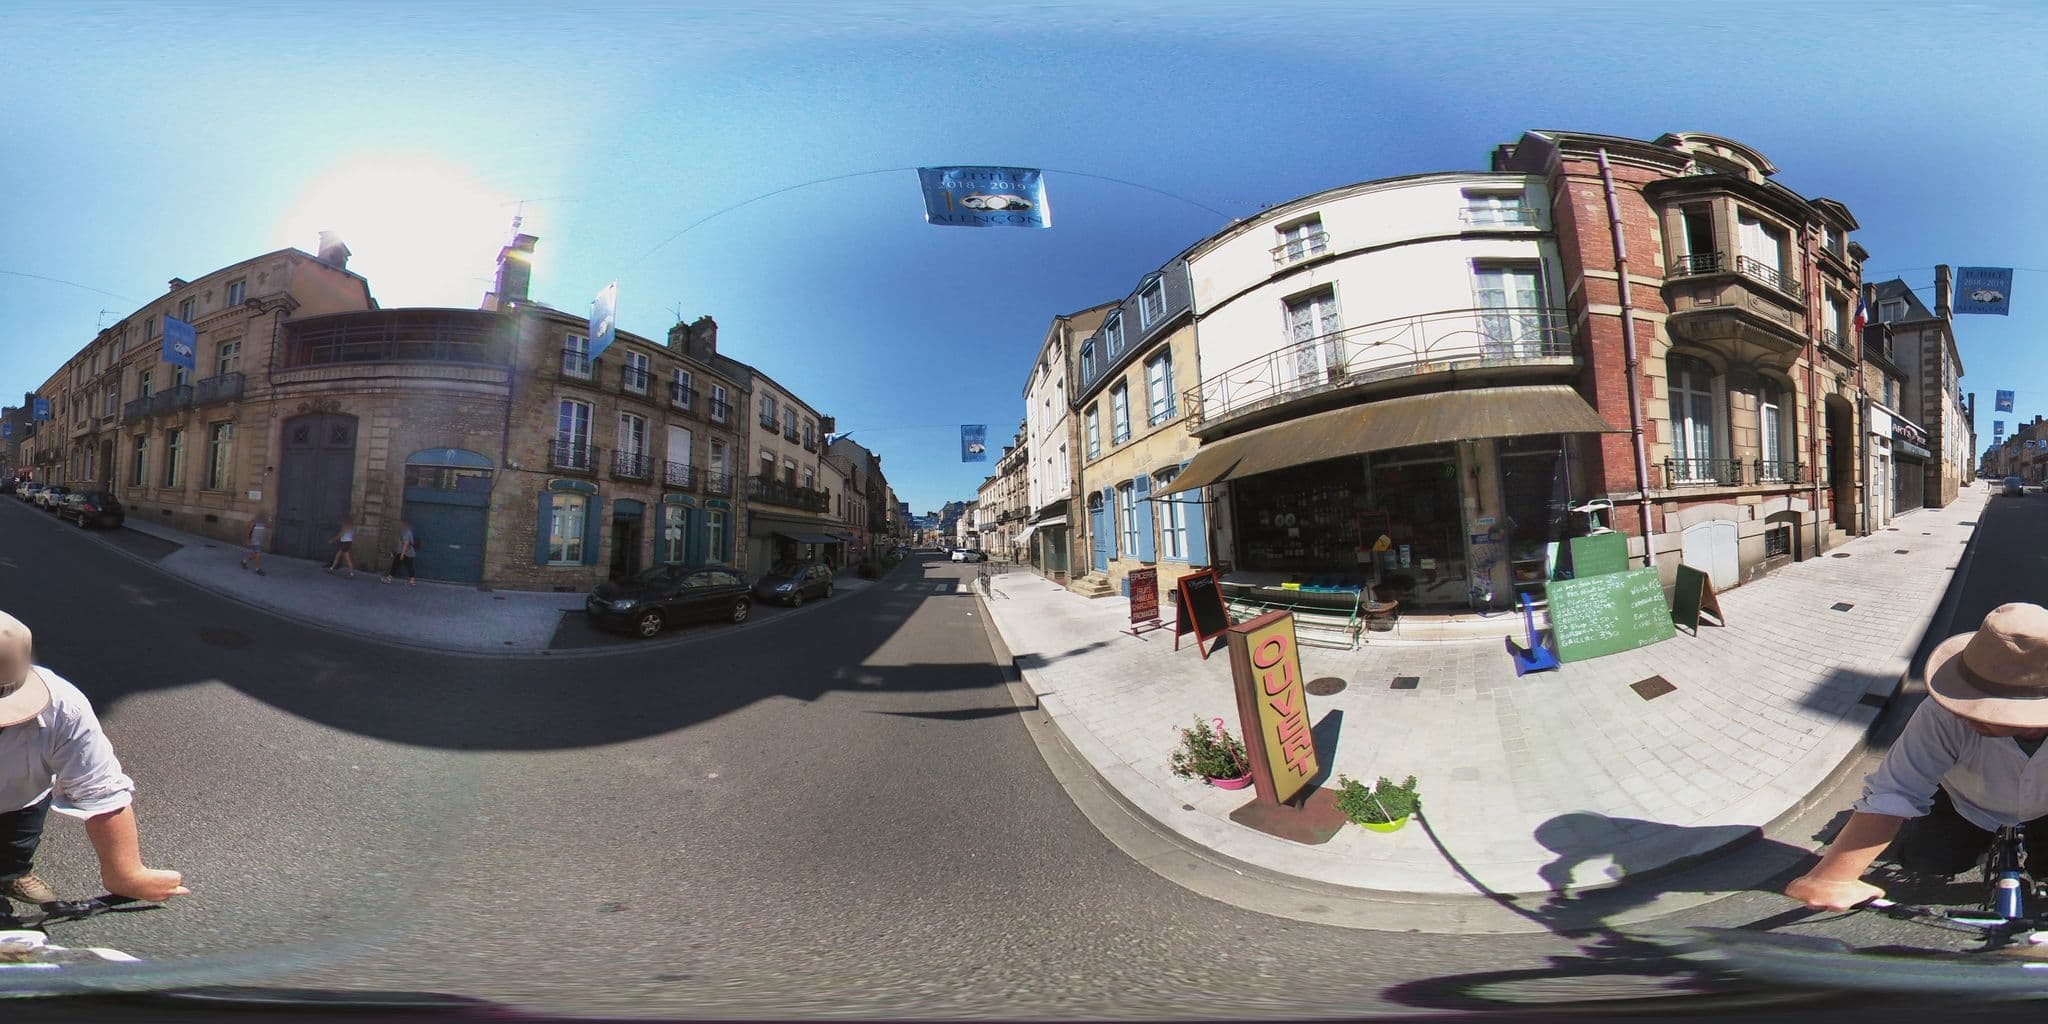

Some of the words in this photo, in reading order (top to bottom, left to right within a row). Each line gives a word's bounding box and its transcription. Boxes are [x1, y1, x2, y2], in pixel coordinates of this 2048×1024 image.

[938, 181, 975, 190] 2018
[990, 181, 1027, 191] 2019
[933, 214, 1043, 225] ALENÇON
[1253, 634, 1314, 777] OUVERT
